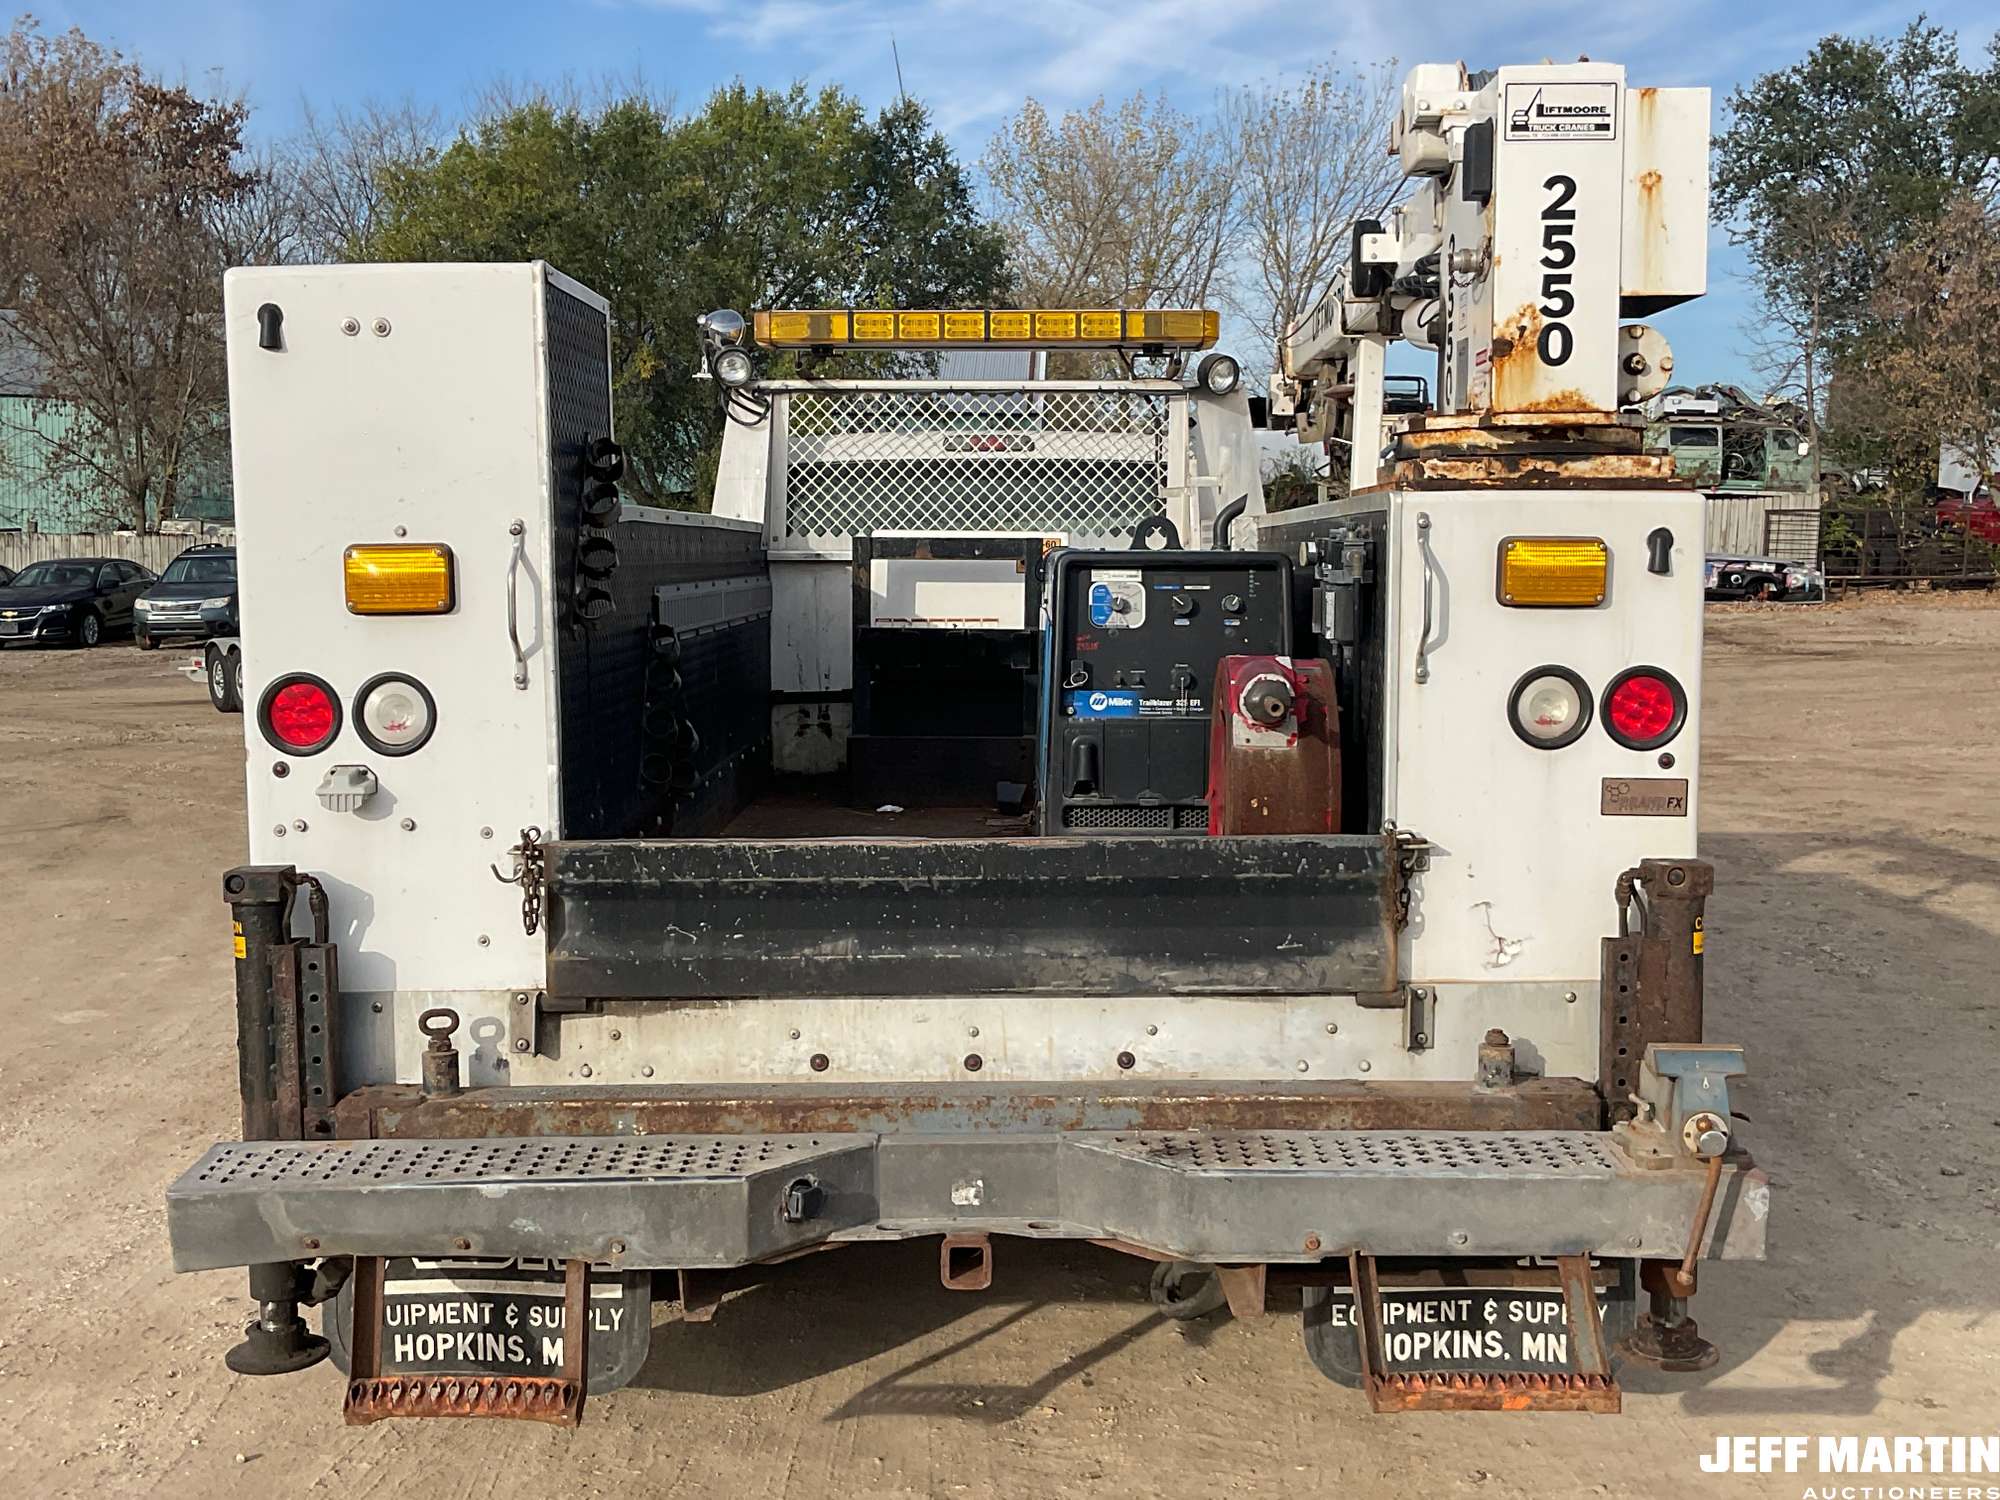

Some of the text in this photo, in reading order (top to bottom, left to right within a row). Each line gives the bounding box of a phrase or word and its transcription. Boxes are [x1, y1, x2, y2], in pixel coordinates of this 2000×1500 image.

[1536, 104, 1607, 117] LIFTMOORE
[1529, 123, 1596, 132] TRUCK CRANES
[1537, 175, 1577, 367] 2550
[1667, 797, 1683, 809] FX
[386, 1302, 624, 1332] UIPMENT & SULY
[1331, 1298, 1608, 1327] EIPMENT & SUPY
[394, 1332, 564, 1367] HOPKINS, M
[1521, 1332, 1567, 1364] MN
